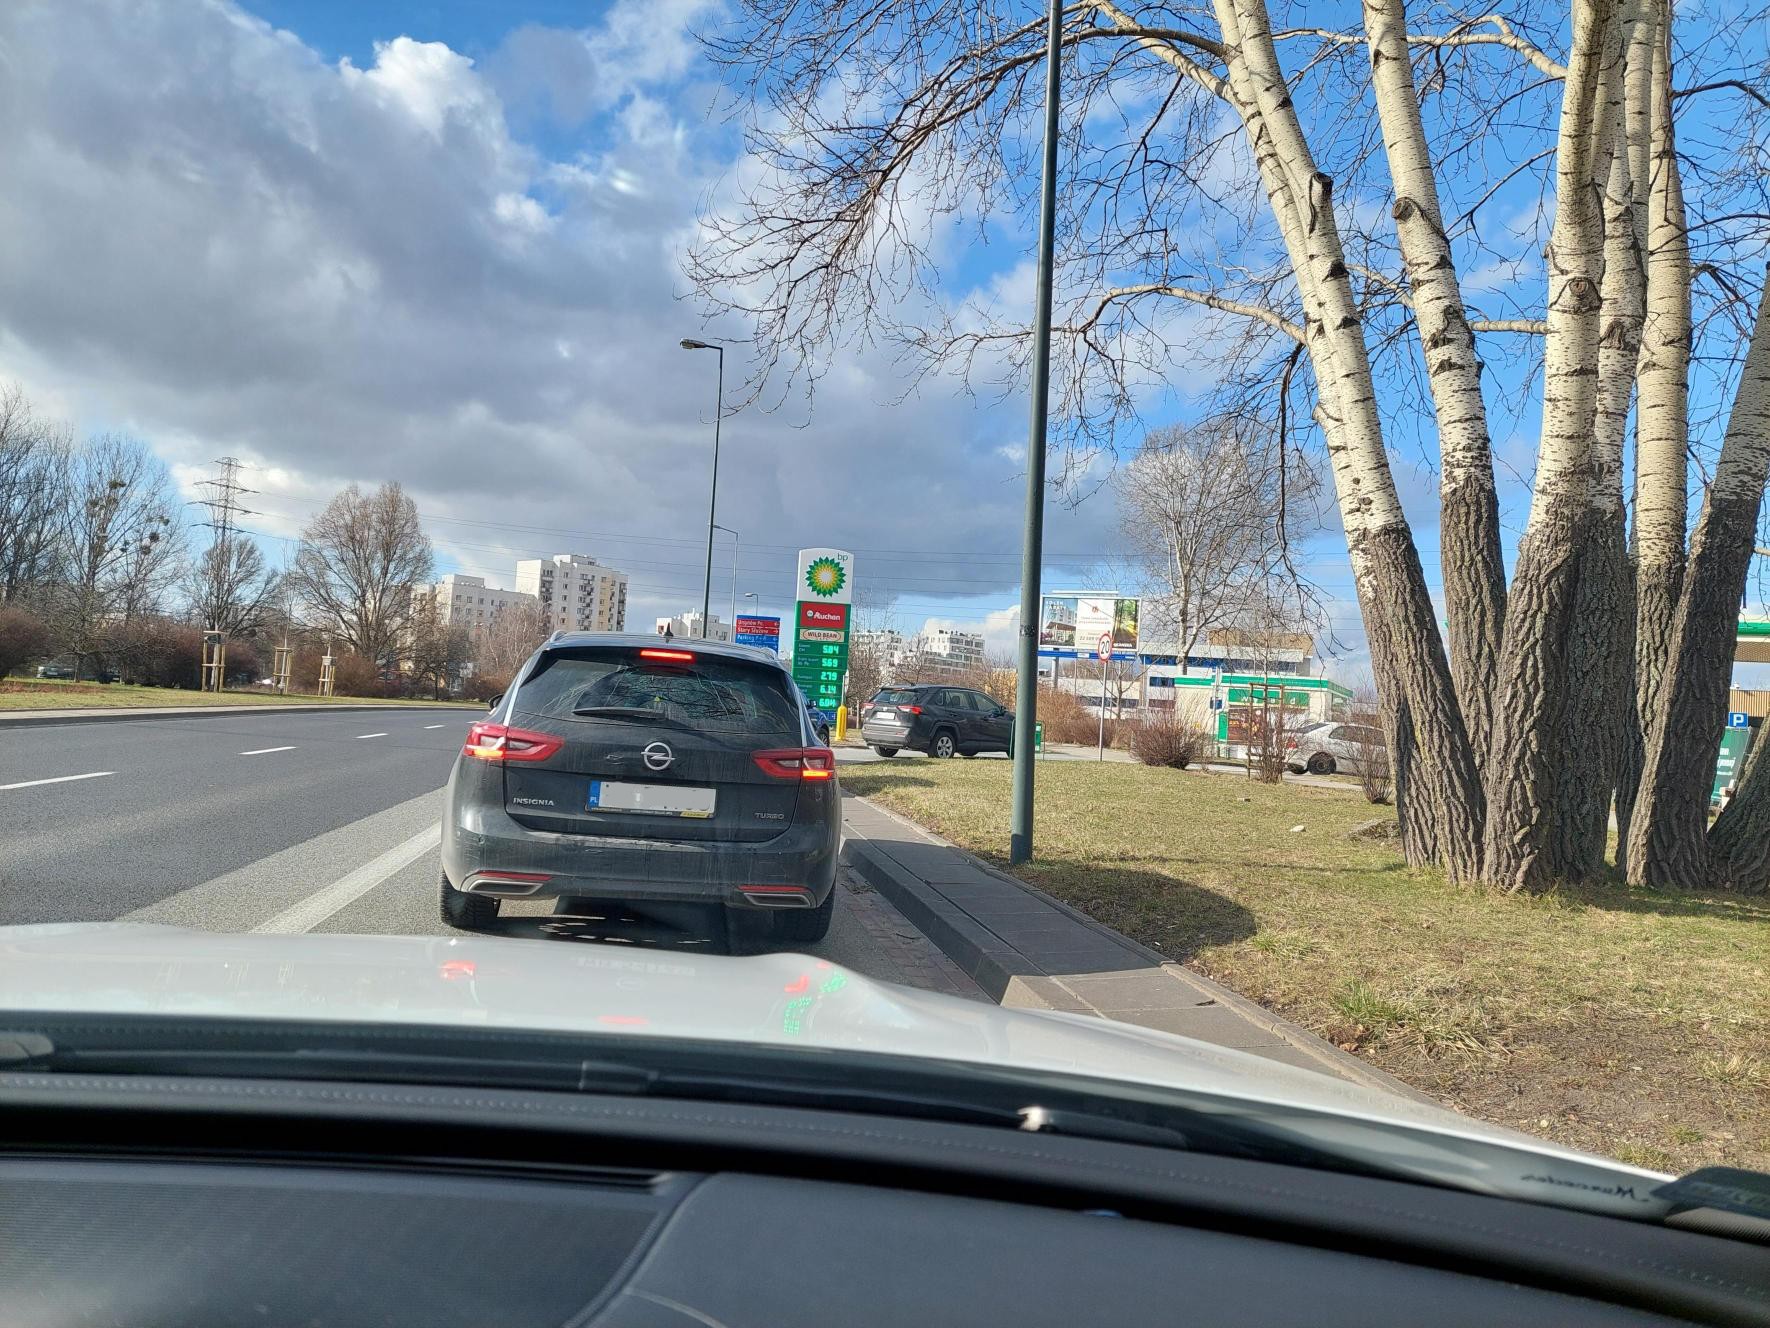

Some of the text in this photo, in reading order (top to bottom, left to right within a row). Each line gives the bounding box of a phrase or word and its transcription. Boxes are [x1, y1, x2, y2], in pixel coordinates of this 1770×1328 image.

[837, 552, 849, 562] bp
[814, 611, 841, 621] Auchan
[1101, 640, 1109, 654] 20
[1733, 714, 1744, 726] P
[513, 797, 554, 806] INSIGNIA
[754, 812, 785, 820] TURBO
